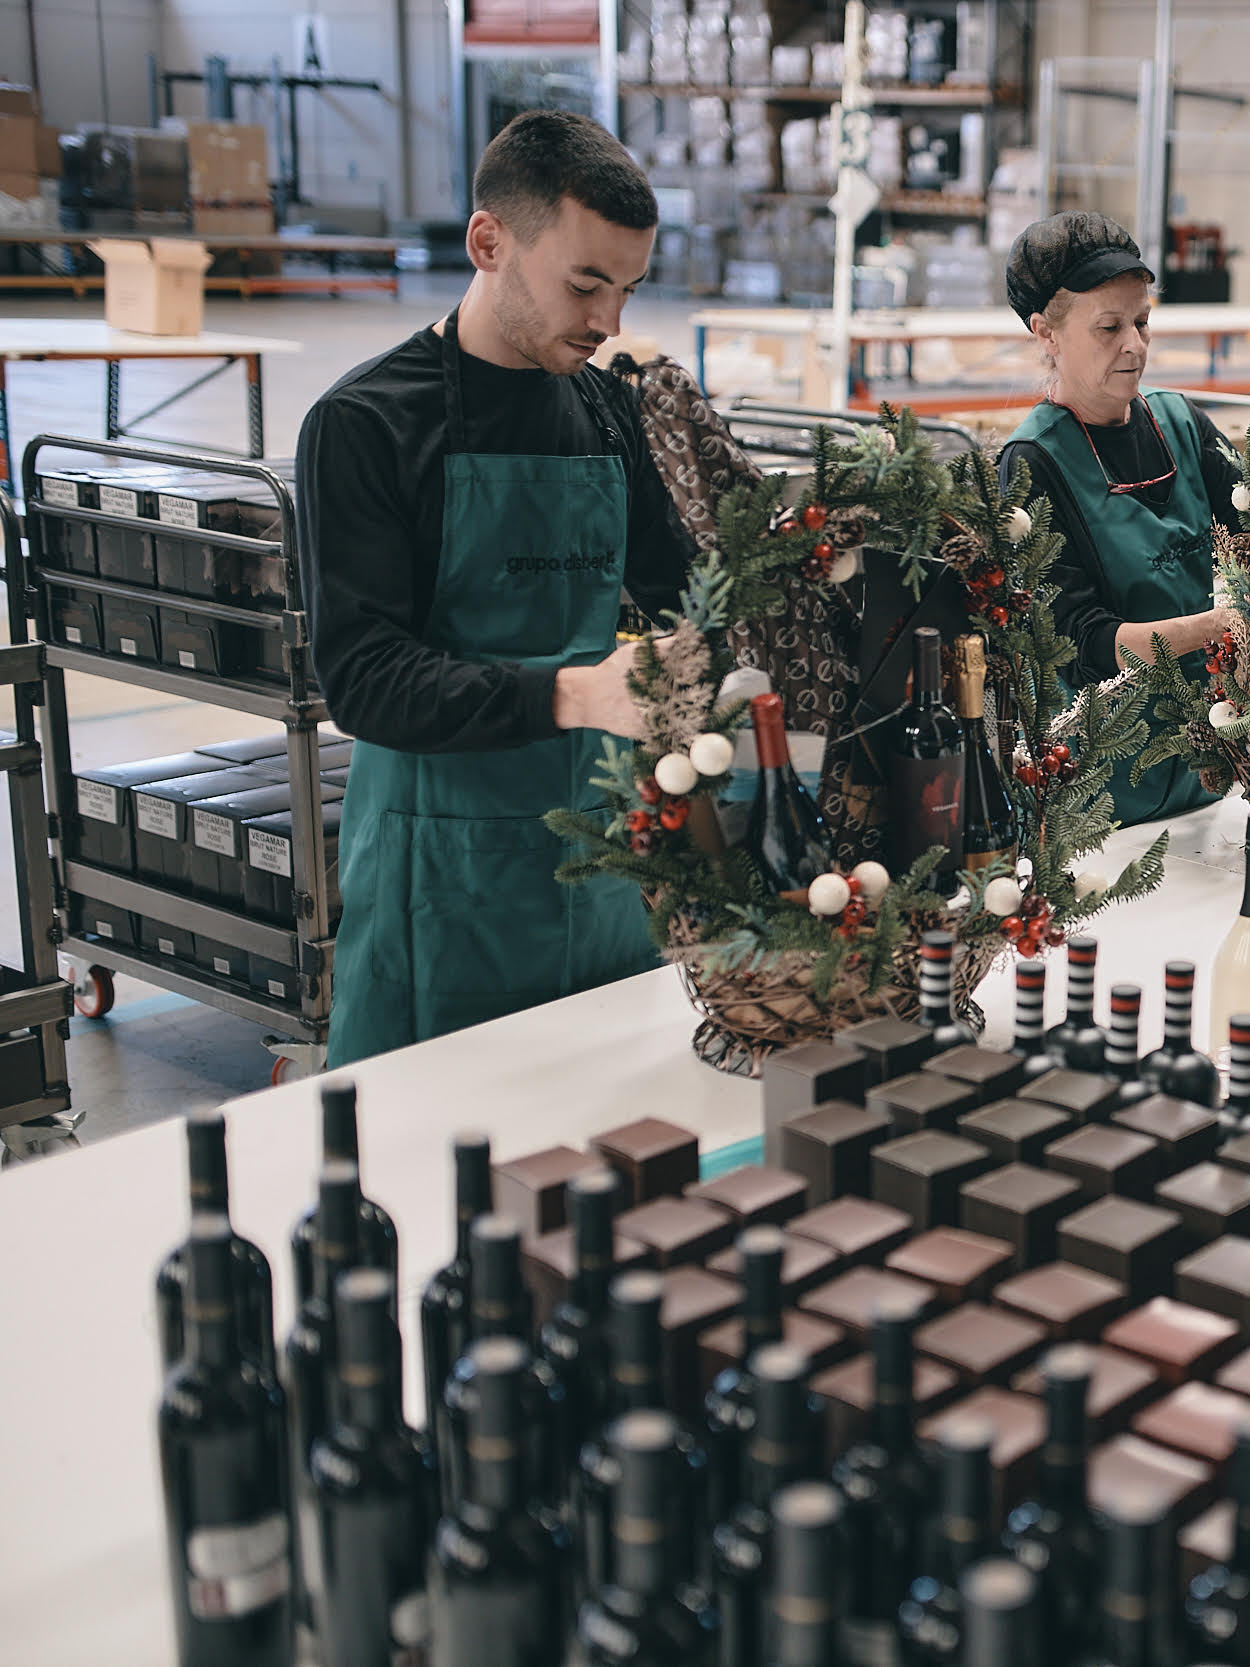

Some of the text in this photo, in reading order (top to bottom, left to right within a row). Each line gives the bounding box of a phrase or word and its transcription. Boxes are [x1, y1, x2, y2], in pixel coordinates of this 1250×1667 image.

[303, 22, 322, 78] A
[161, 497, 193, 510] VEGAMAR
[506, 556, 562, 575] grupo
[196, 812, 229, 828] VEGAMAR
[251, 831, 285, 847] VEGAMAR
[265, 845, 287, 856] NATURE
